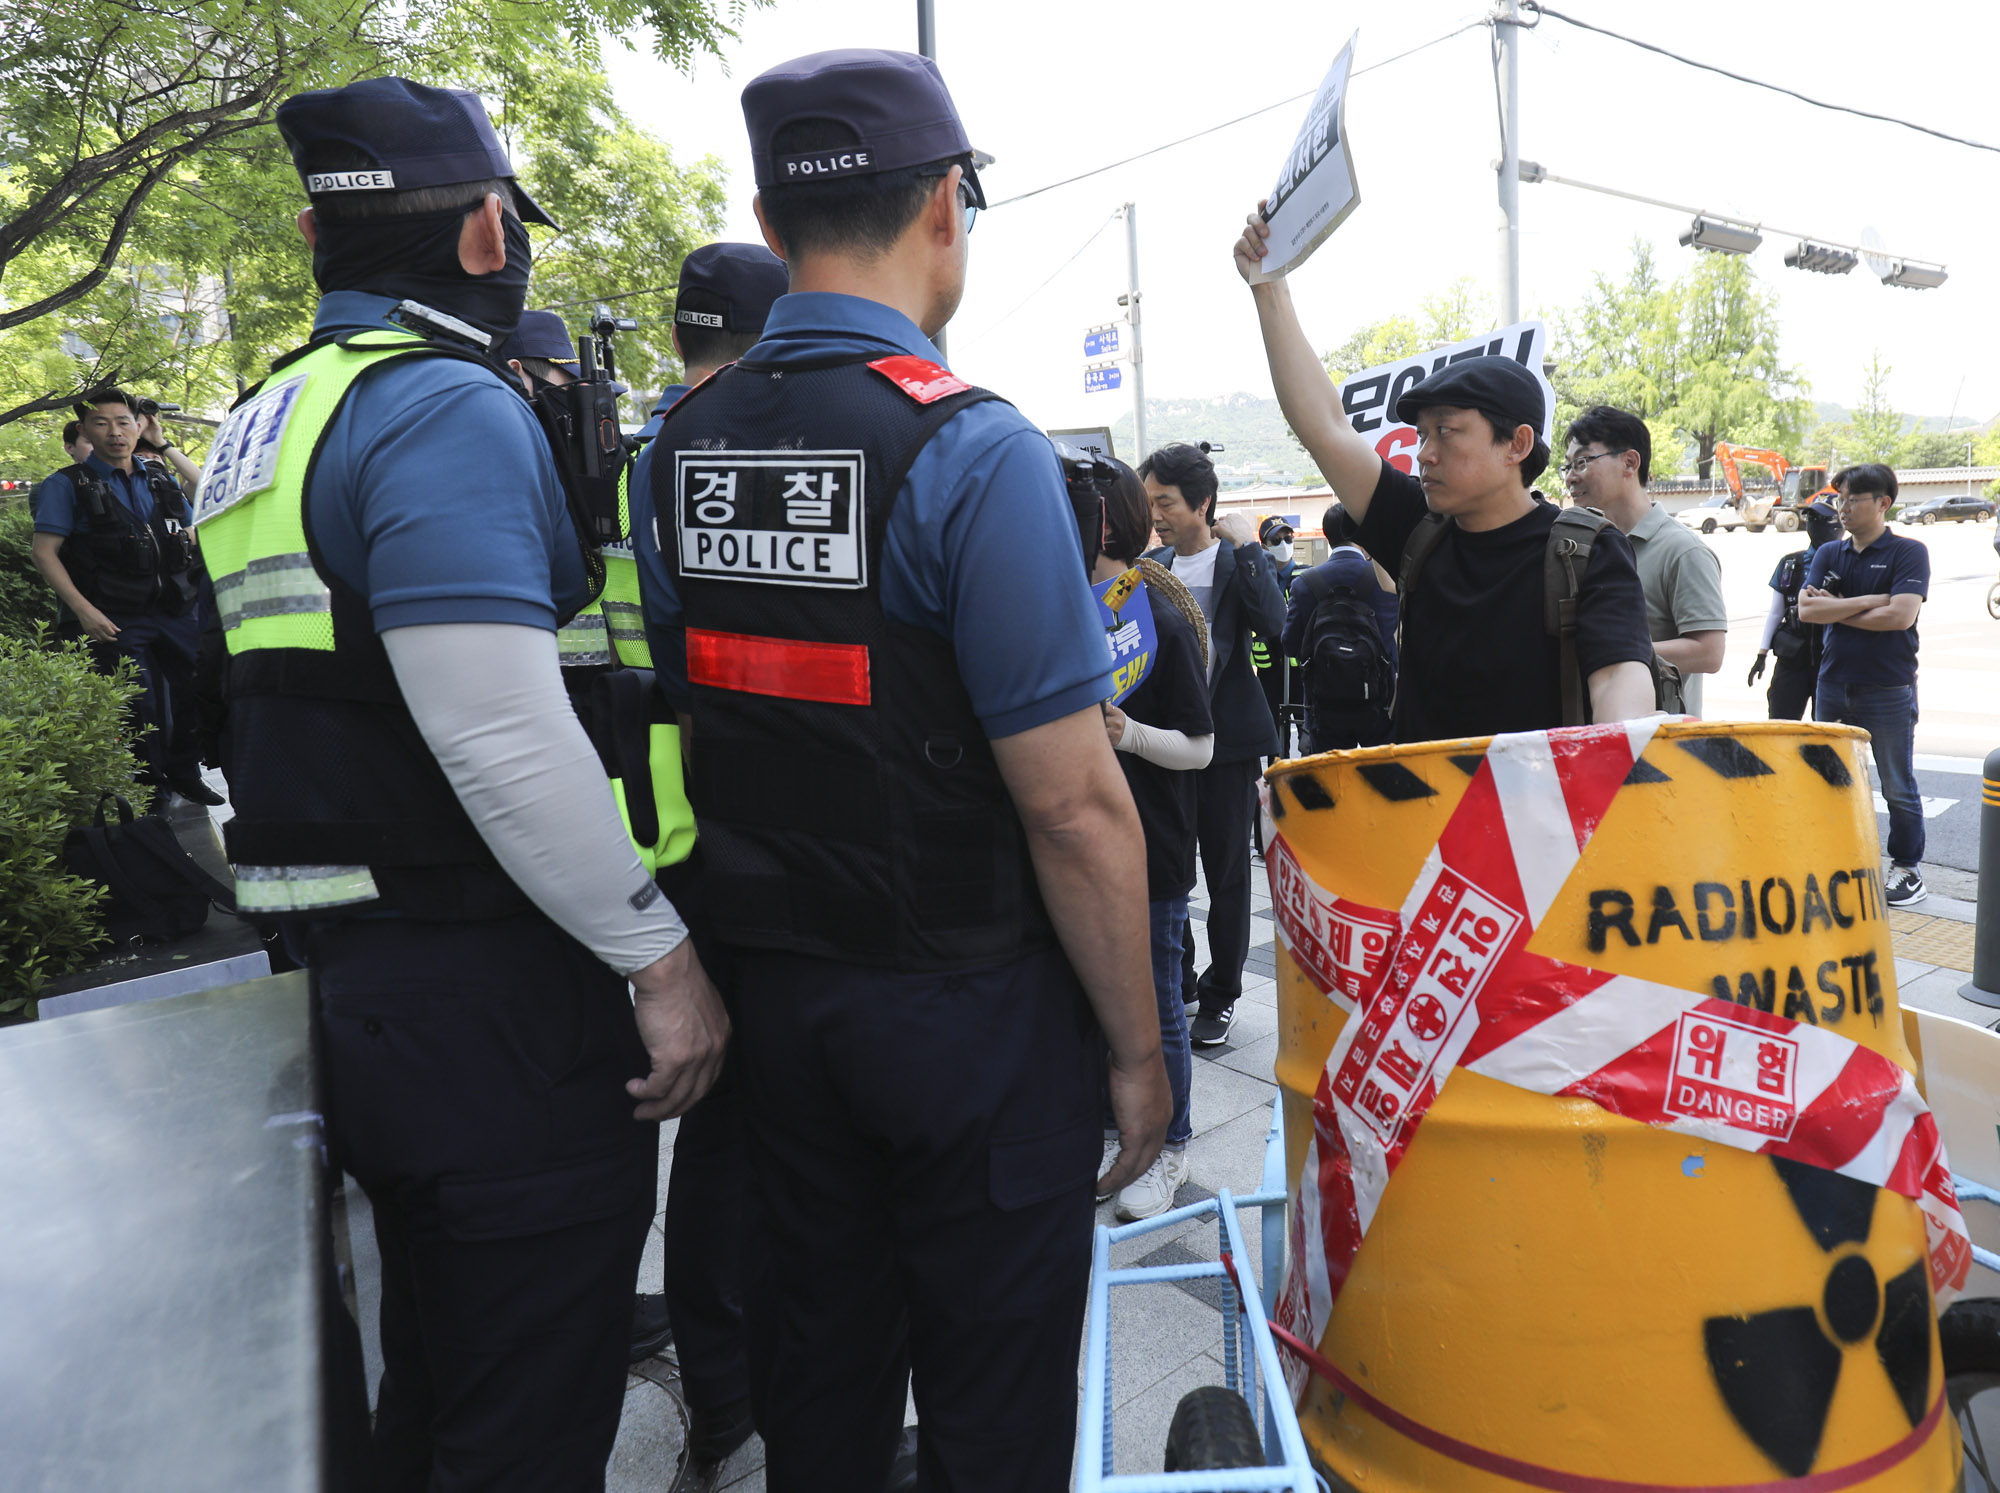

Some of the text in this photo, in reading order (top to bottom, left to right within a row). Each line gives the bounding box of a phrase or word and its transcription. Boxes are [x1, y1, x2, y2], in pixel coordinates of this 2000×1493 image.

[313, 173, 385, 190] POLICE
[787, 153, 869, 175] POLICE
[679, 311, 718, 326] POLICE
[692, 471, 840, 526] 경찰
[697, 532, 831, 573] POLICE
[1711, 949, 1885, 1025] WASTE
[1359, 907, 1501, 1130] 안전 제일
[1688, 1024, 1788, 1096] 위험
[1678, 1084, 1788, 1130] DANGER
